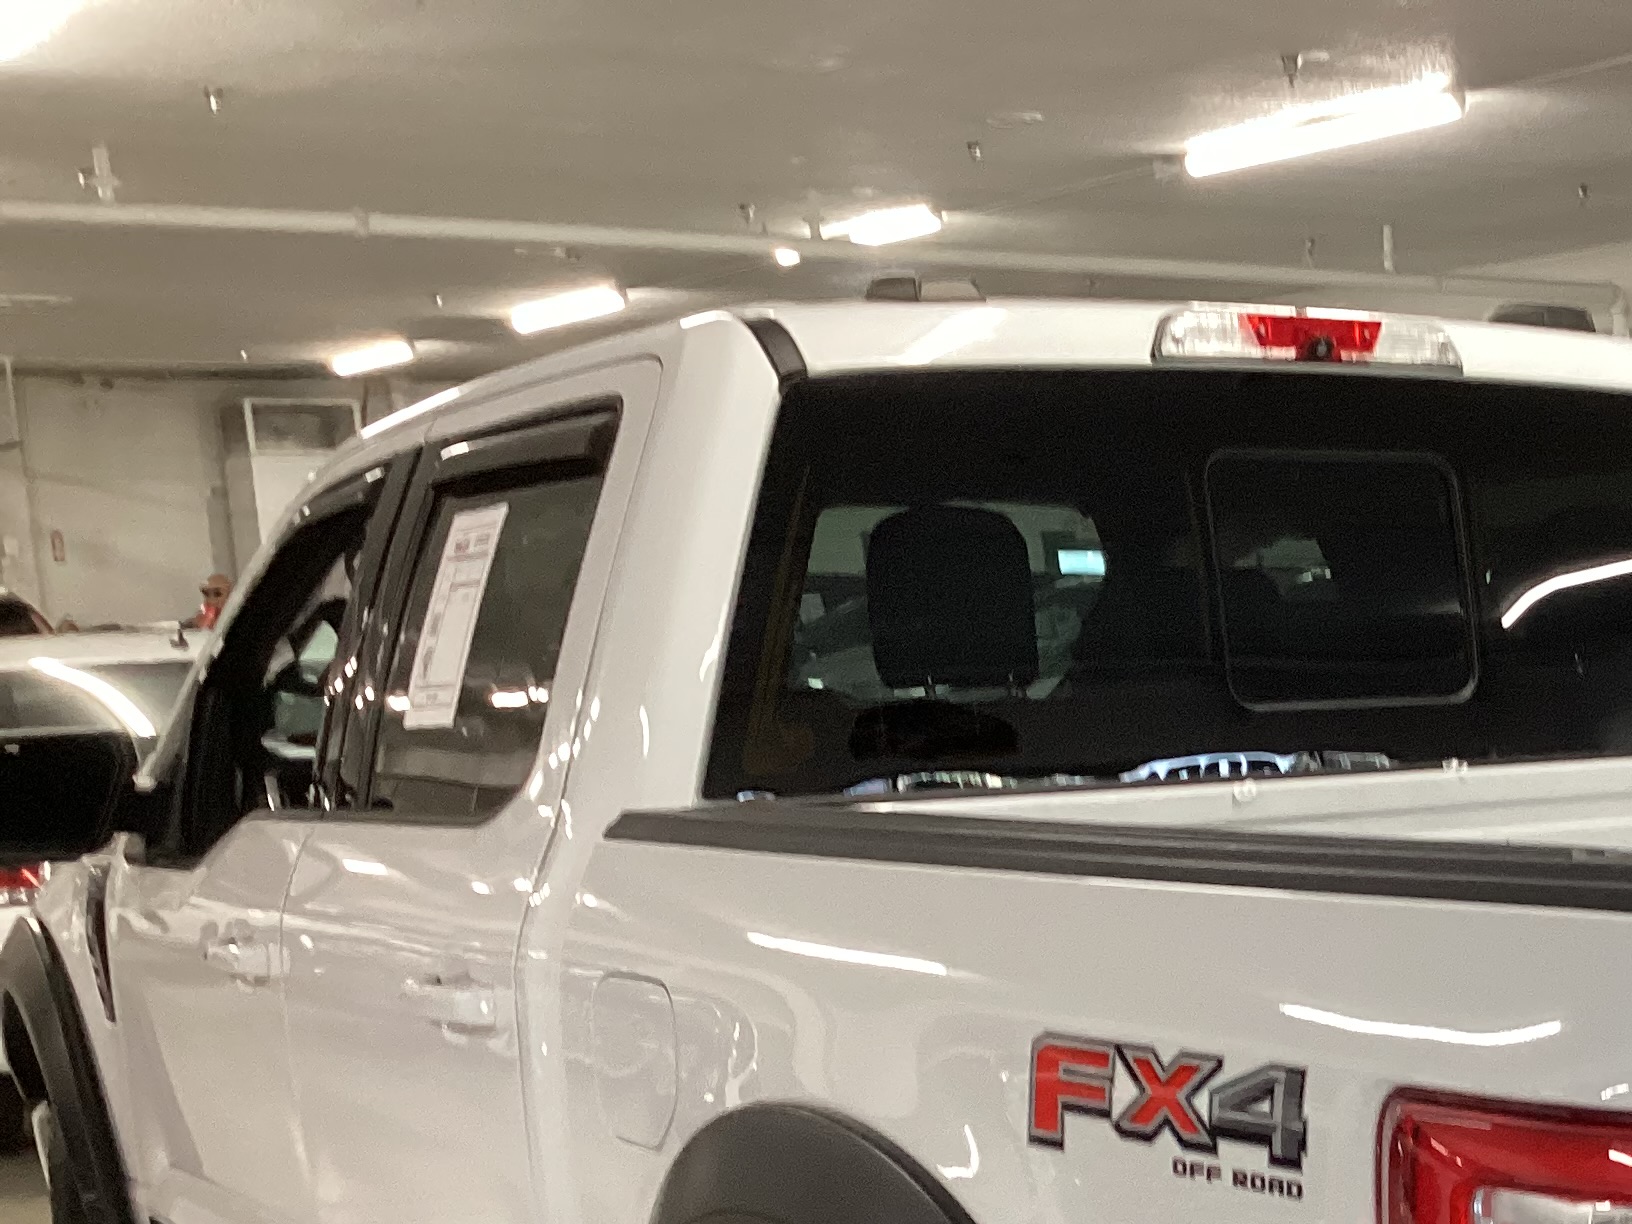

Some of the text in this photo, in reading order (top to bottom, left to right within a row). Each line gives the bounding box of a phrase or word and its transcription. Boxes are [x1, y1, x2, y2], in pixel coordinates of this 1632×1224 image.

[1028, 1032, 1308, 1170] FX4
[1172, 1156, 1304, 1200] OFF ROAD
